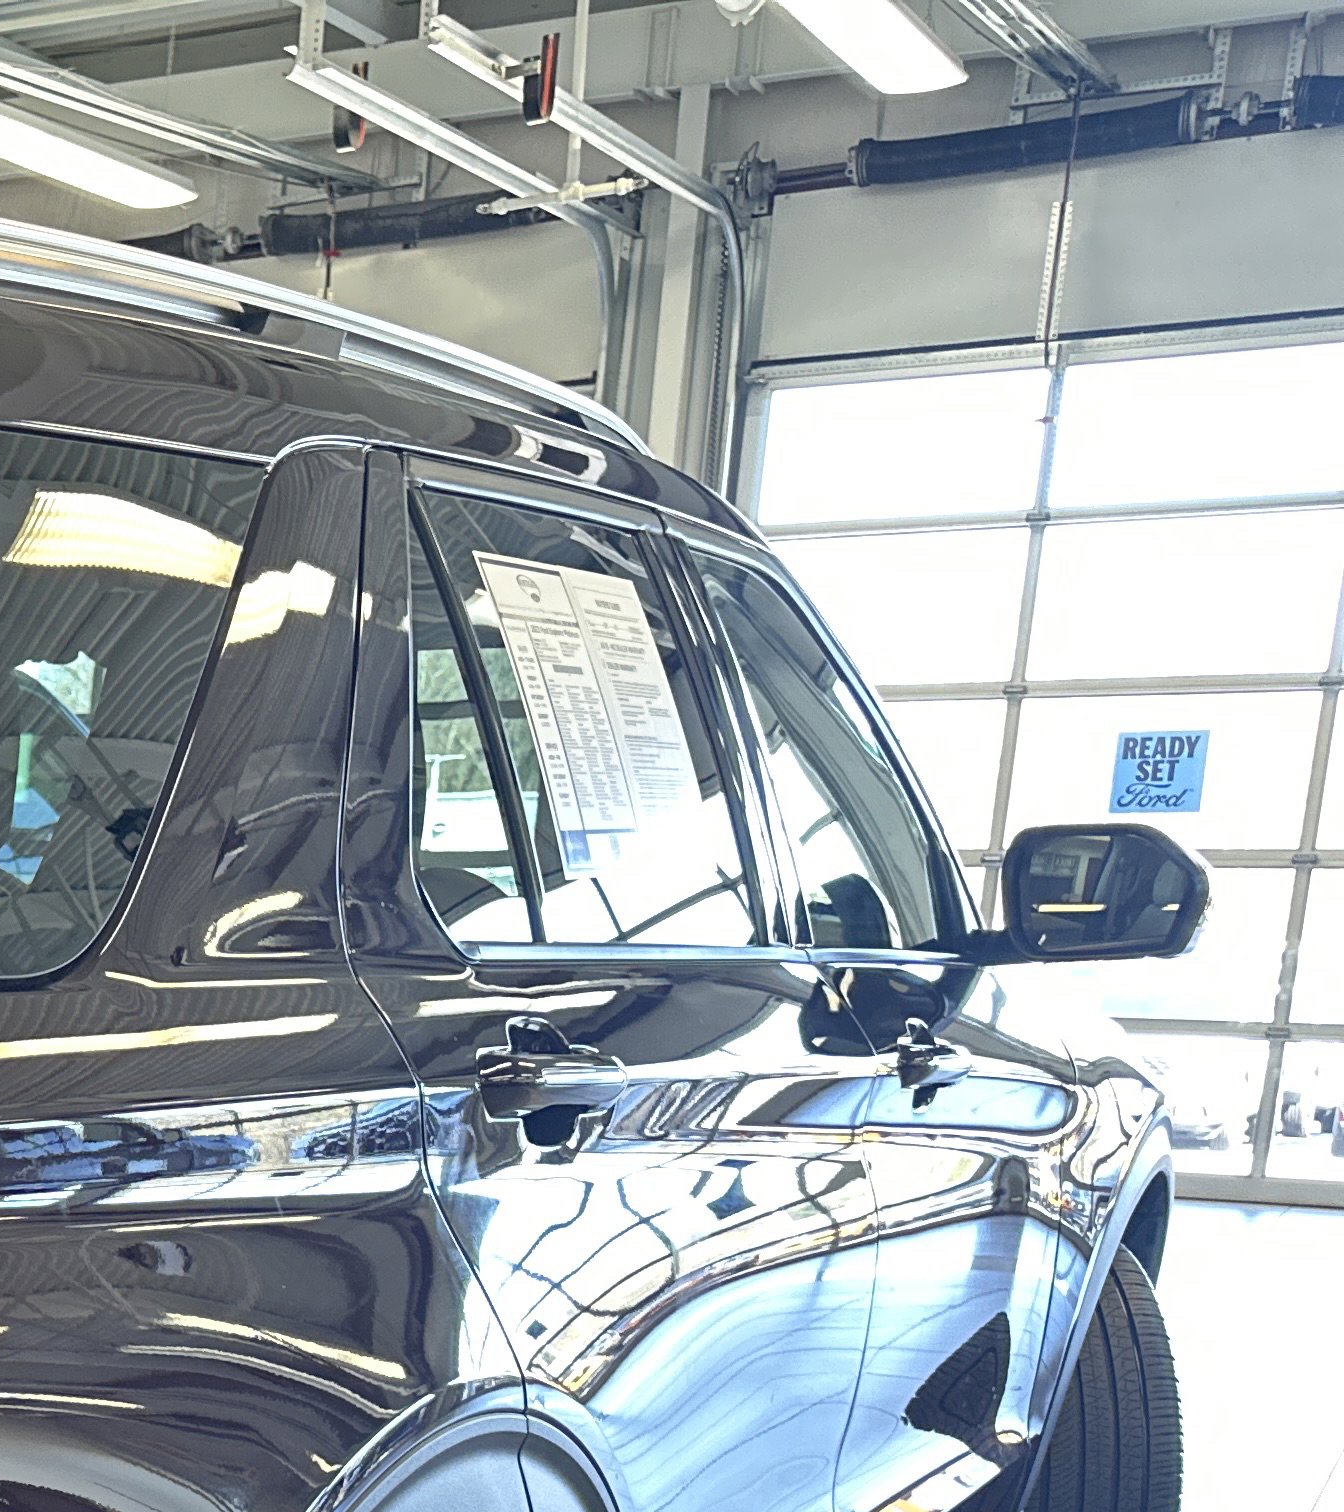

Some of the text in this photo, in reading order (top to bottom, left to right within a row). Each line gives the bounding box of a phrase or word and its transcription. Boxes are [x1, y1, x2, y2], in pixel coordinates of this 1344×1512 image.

[1122, 736, 1201, 759] READY
[1135, 760, 1179, 782] SET
[1117, 783, 1188, 808] Ford
